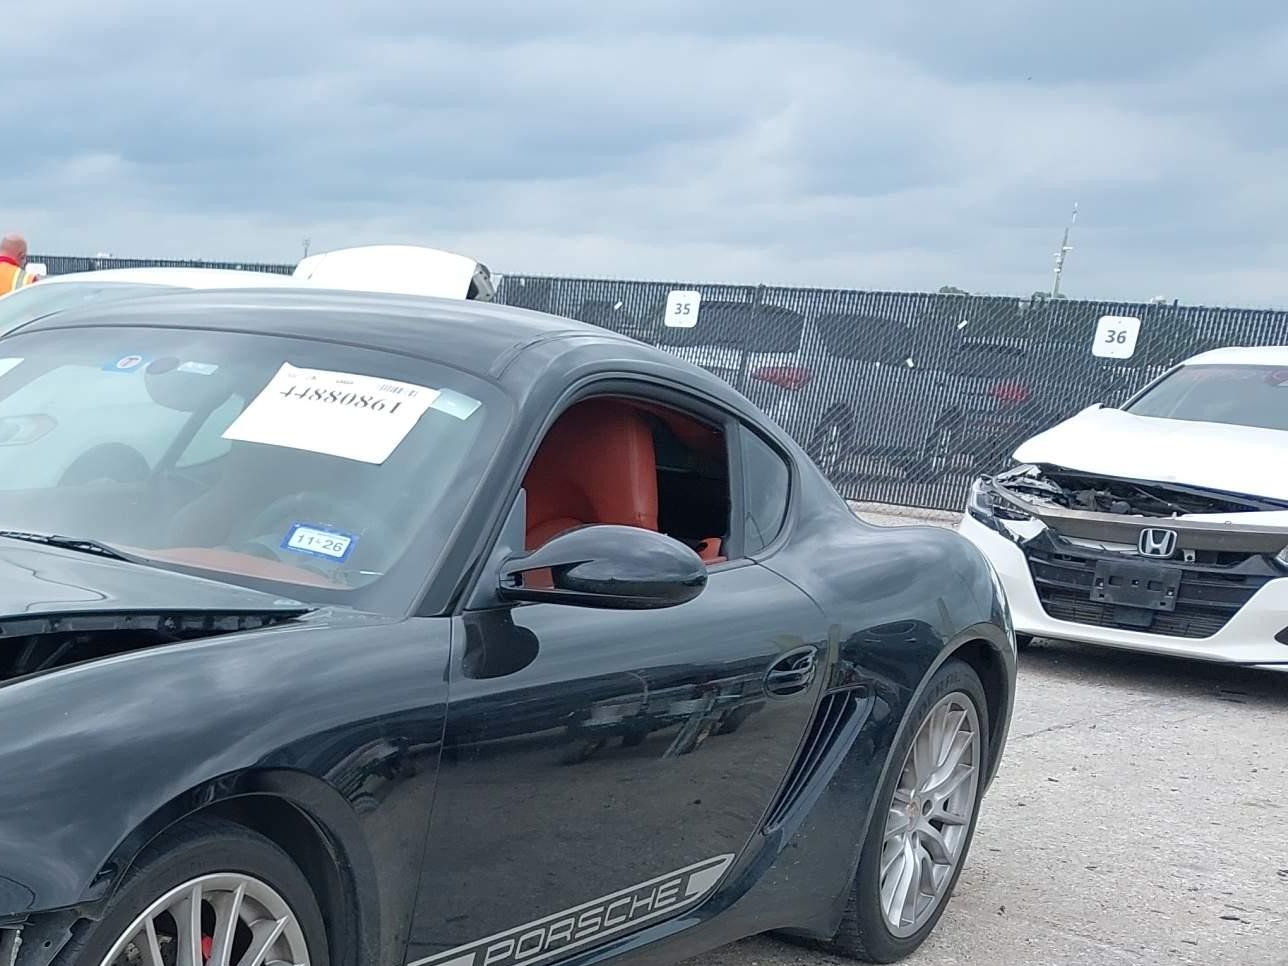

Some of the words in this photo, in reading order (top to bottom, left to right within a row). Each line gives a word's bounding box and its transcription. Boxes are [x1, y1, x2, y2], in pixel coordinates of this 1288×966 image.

[674, 302, 691, 315] 35
[1104, 329, 1128, 344] 36
[280, 386, 402, 413] 44880861
